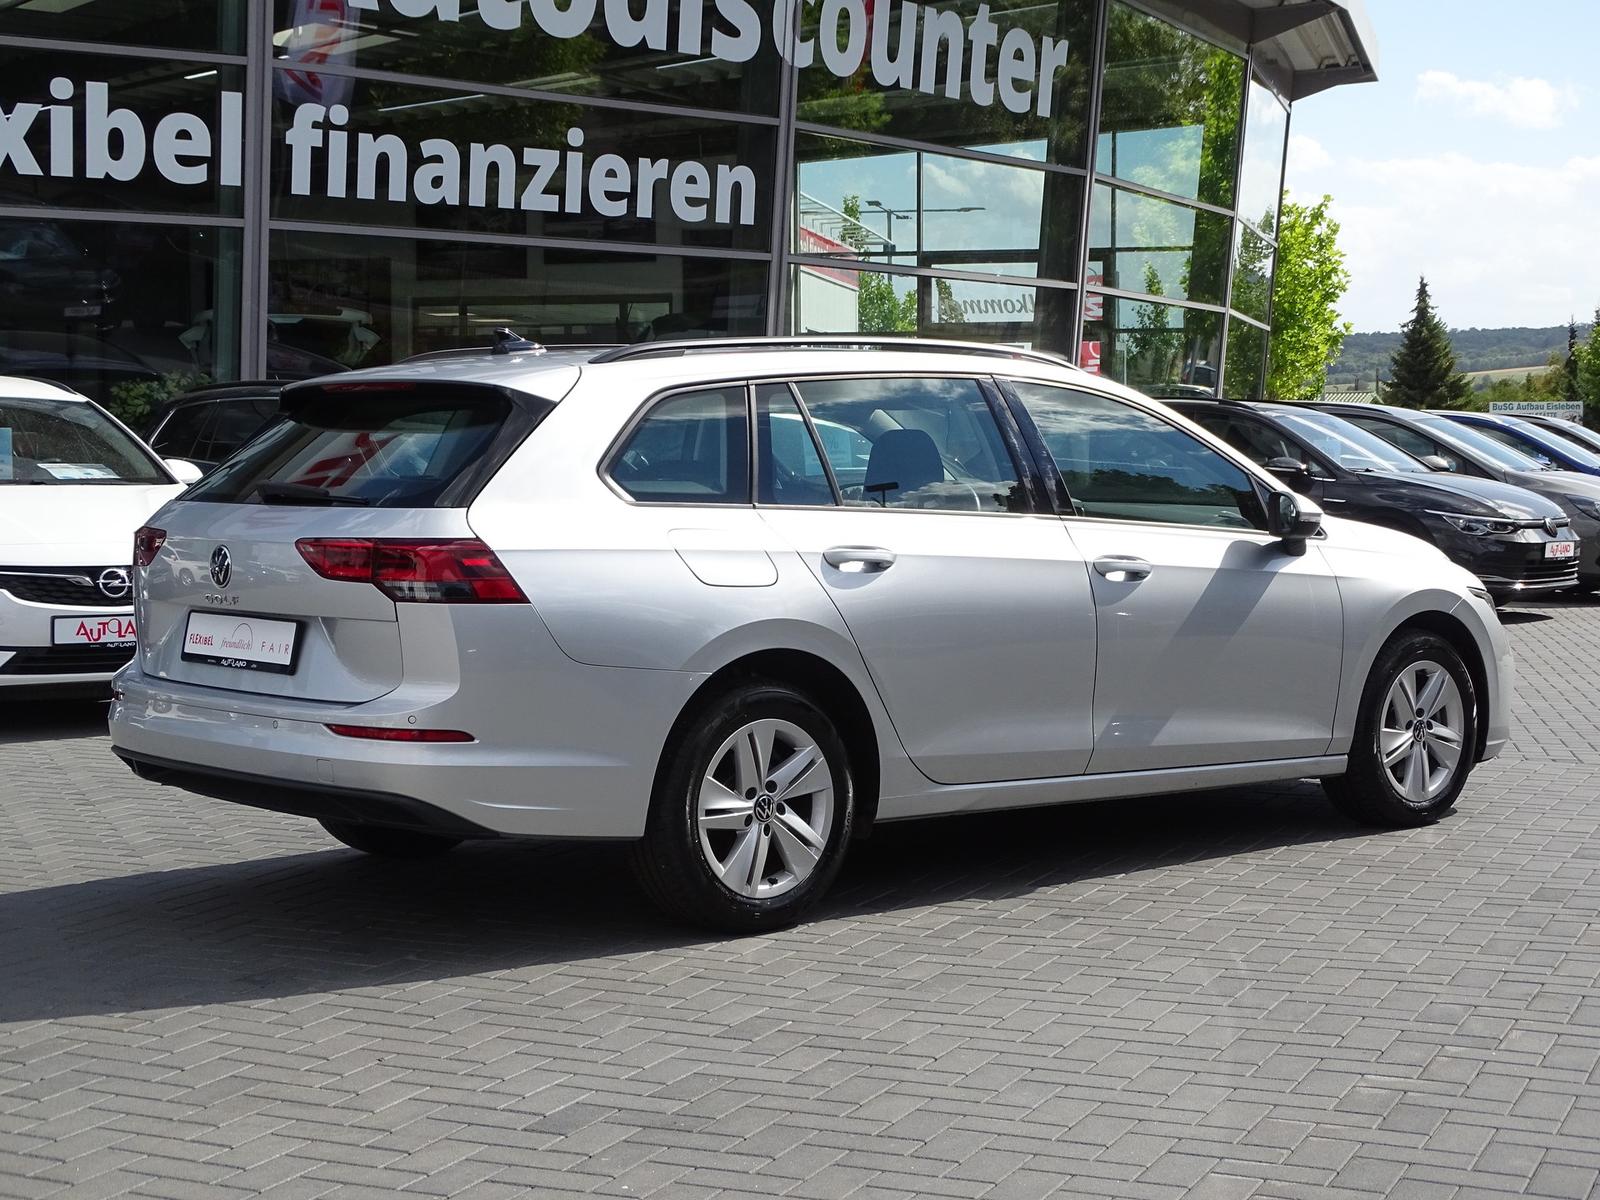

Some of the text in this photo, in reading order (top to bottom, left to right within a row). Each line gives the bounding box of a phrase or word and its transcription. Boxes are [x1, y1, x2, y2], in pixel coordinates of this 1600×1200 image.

[285, 103, 756, 226] finanzieren
[1516, 402, 1545, 411] Aufbau
[1546, 402, 1581, 411] Eisleben
[261, 641, 290, 655] FAIR
